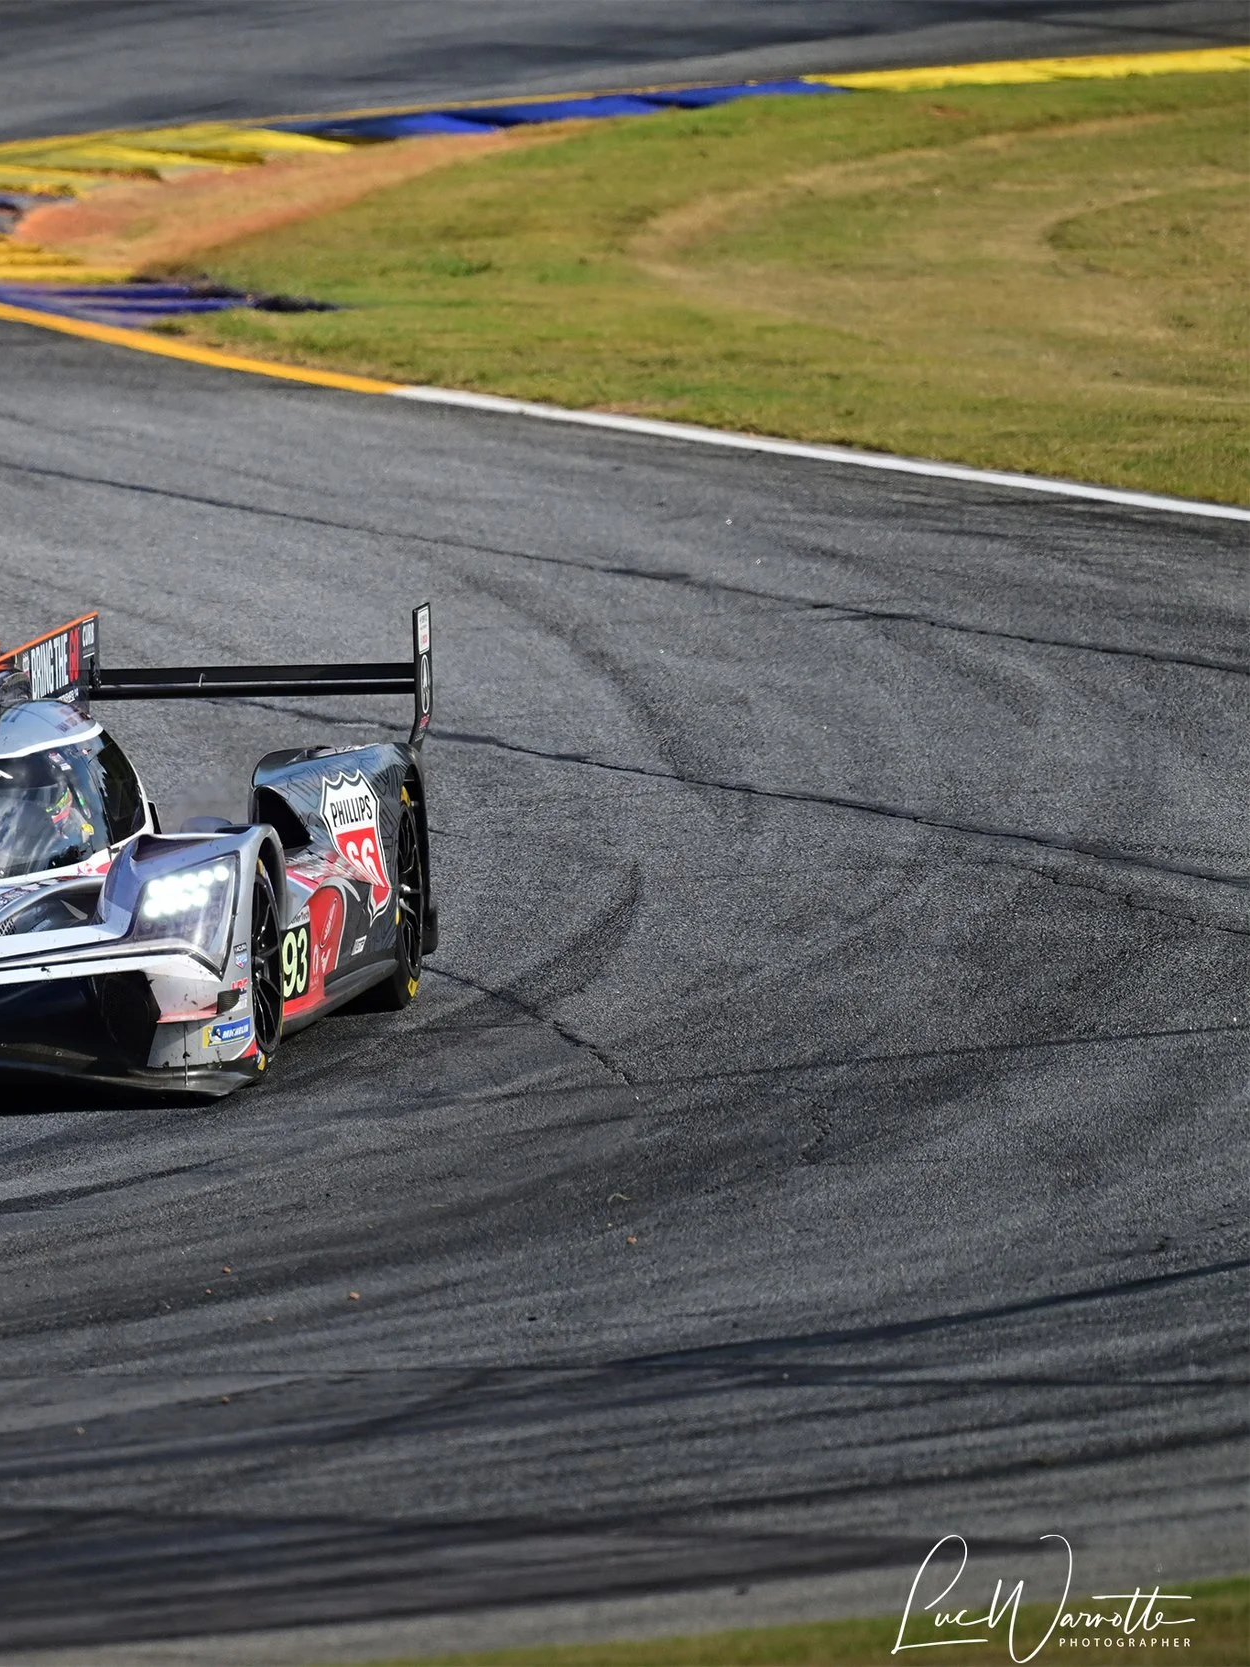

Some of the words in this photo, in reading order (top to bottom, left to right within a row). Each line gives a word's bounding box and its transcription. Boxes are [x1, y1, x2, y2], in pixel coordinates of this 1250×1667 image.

[31, 639, 54, 700] BRING
[53, 632, 69, 690] THE
[330, 794, 373, 828] PHILLIPS
[346, 837, 385, 888] 66
[282, 927, 308, 998] 93
